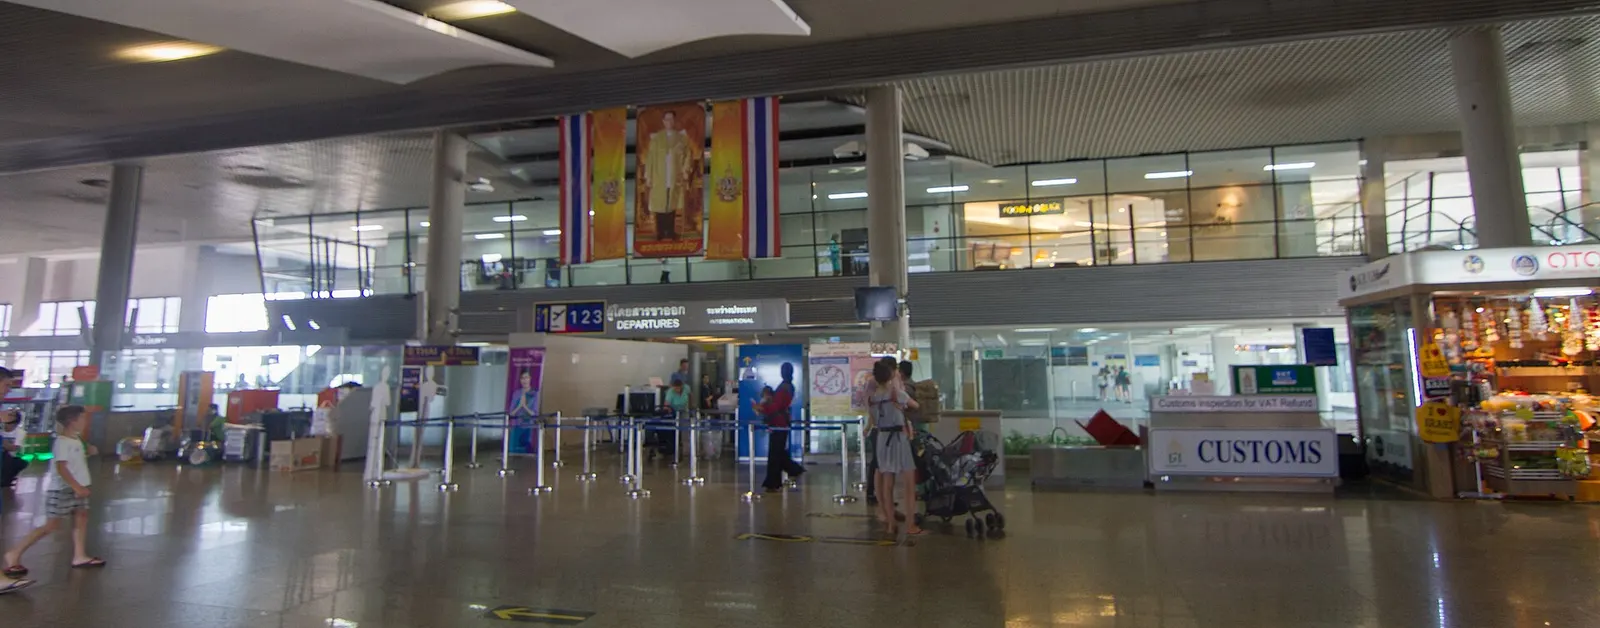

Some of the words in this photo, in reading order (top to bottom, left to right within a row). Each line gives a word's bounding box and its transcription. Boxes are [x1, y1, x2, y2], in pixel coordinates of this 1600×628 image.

[617, 318, 680, 330] DEPARTURES
[709, 317, 755, 325] INTERNATIONAL
[1158, 398, 1197, 408] Customs
[1244, 399, 1255, 408] for
[1260, 398, 1277, 408] VAT
[1281, 398, 1313, 408] Refund
[1197, 439, 1322, 464] CUSTOMS
